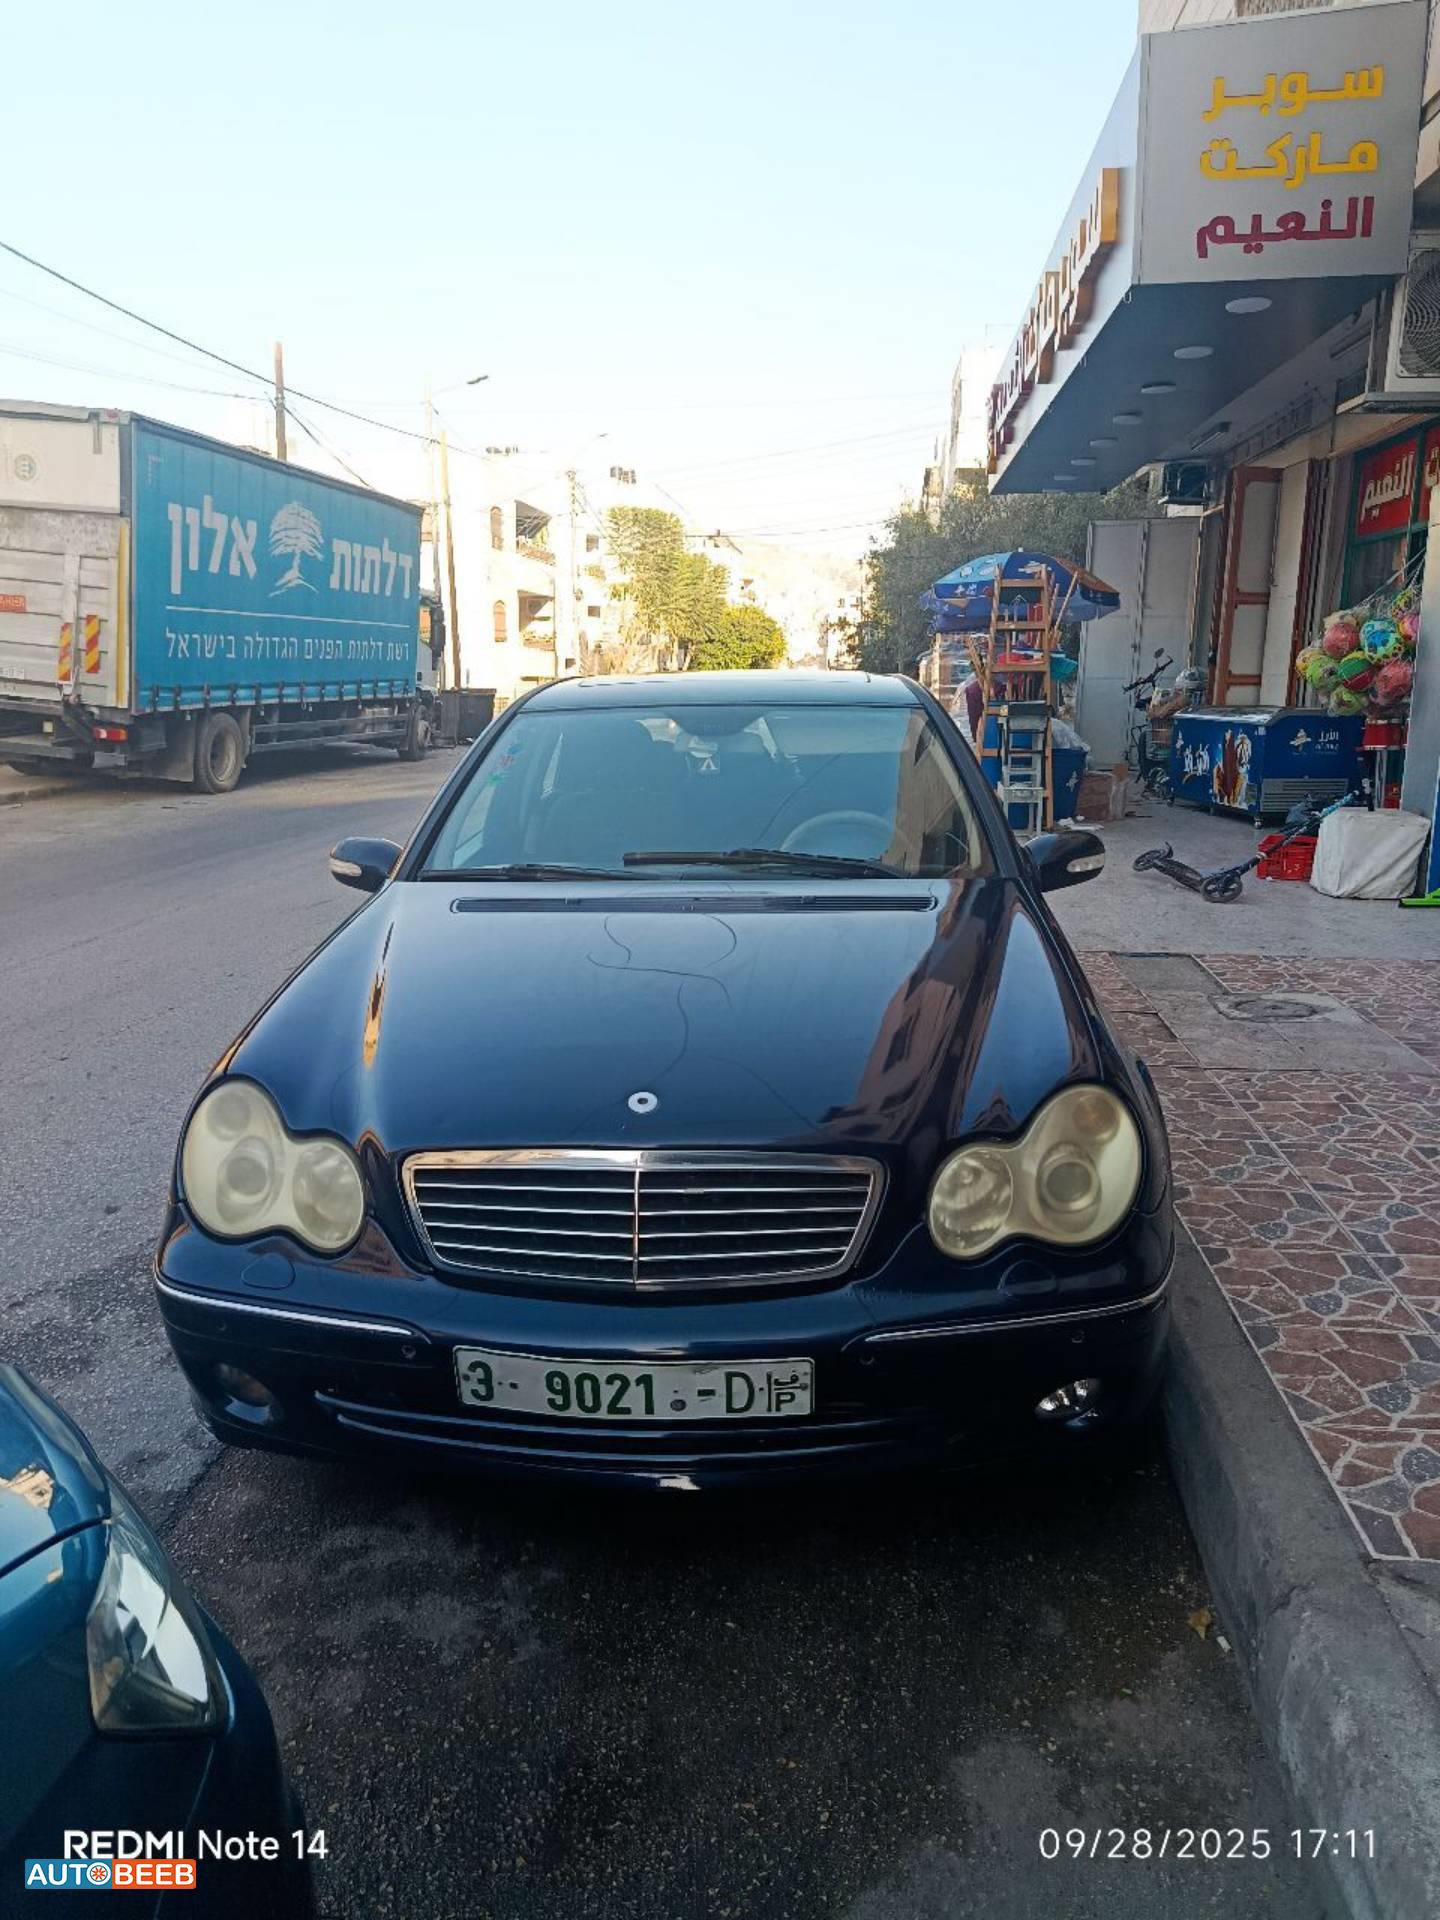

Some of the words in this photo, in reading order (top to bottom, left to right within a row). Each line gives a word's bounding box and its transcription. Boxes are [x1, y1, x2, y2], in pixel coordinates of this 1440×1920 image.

[1202, 64, 1385, 122] سوبر
[1200, 131, 1379, 191] ماركت
[1196, 196, 1375, 259] النعيم
[167, 494, 258, 595] אלון
[329, 536, 413, 600] דלתות
[165, 626, 236, 660] בישראל
[243, 631, 299, 660] הגדולה
[304, 638, 343, 660] הפנים
[347, 636, 384, 662] דלתות
[386, 642, 409, 661] רשת
[544, 1370, 655, 1415] 9021
